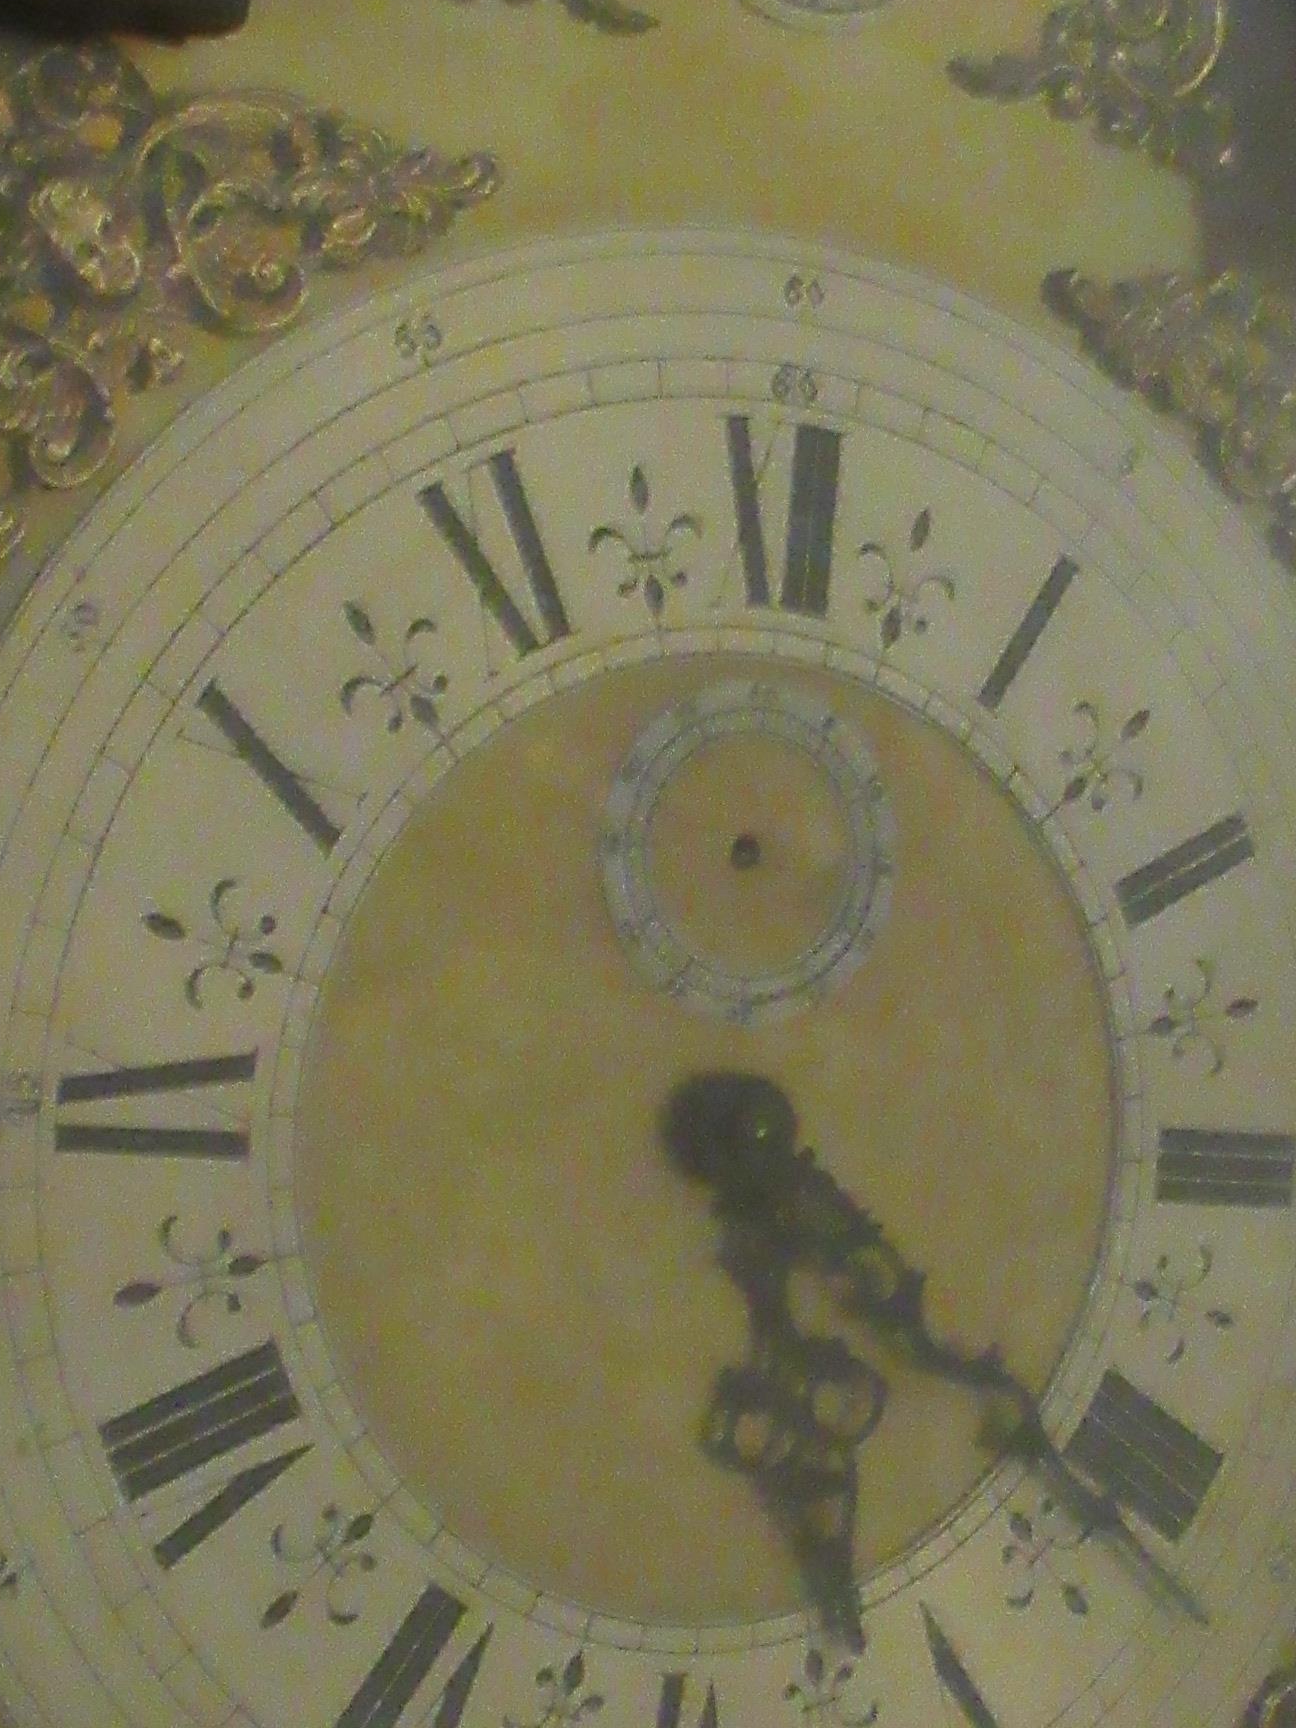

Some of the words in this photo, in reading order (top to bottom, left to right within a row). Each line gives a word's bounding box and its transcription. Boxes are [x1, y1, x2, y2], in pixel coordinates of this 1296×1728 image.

[394, 312, 444, 370] 55
[784, 274, 826, 310] 60
[416, 447, 579, 684] XI
[710, 414, 842, 620] XII
[976, 552, 1080, 714] I
[1113, 810, 1255, 929] II
[54, 1038, 257, 1163] IX
[99, 1339, 314, 1572] VIII
